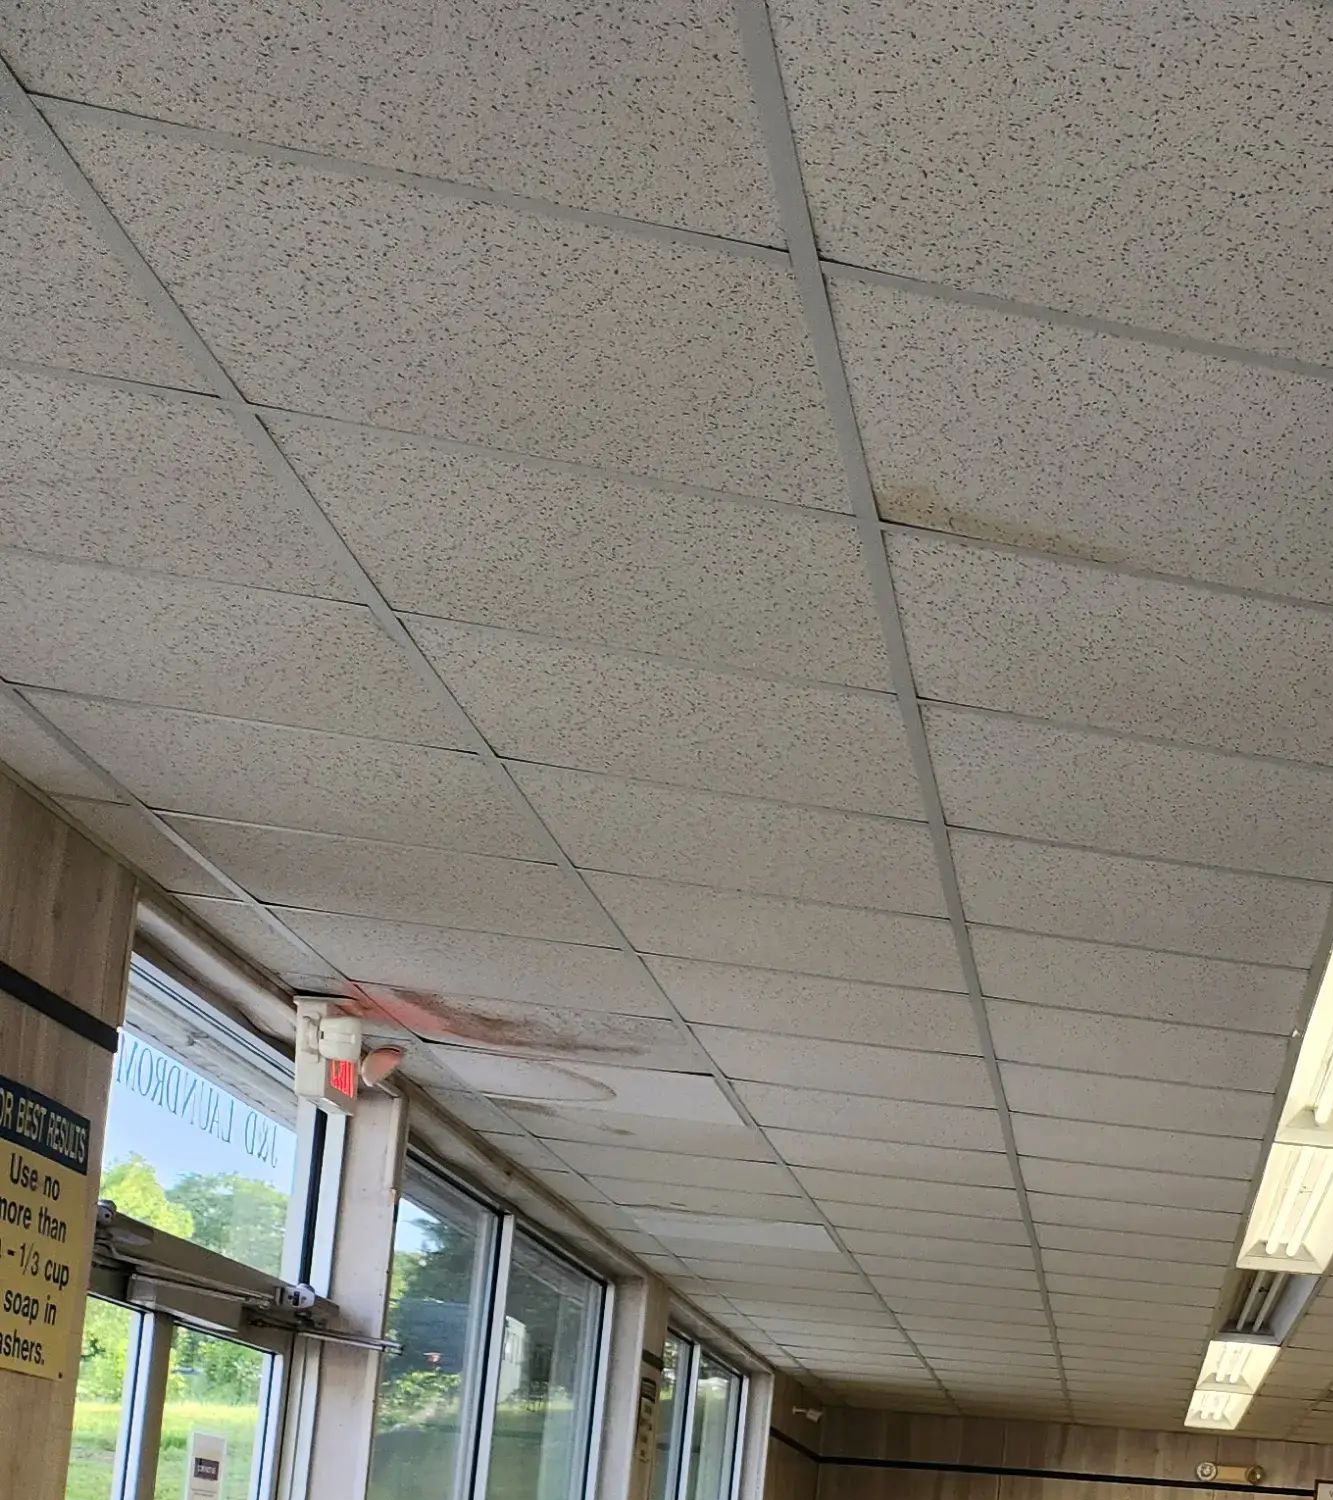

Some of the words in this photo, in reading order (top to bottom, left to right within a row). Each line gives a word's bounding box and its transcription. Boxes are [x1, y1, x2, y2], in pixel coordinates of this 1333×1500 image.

[16, 1096, 47, 1140] BEST
[47, 1109, 87, 1162] RESULTS
[9, 1152, 38, 1191] Use
[44, 1176, 60, 1201] no
[38, 1205, 67, 1243] than
[19, 1241, 39, 1276] 1/3
[44, 1260, 69, 1290] cup
[4, 1289, 39, 1325] soap
[44, 1294, 56, 1325] in
